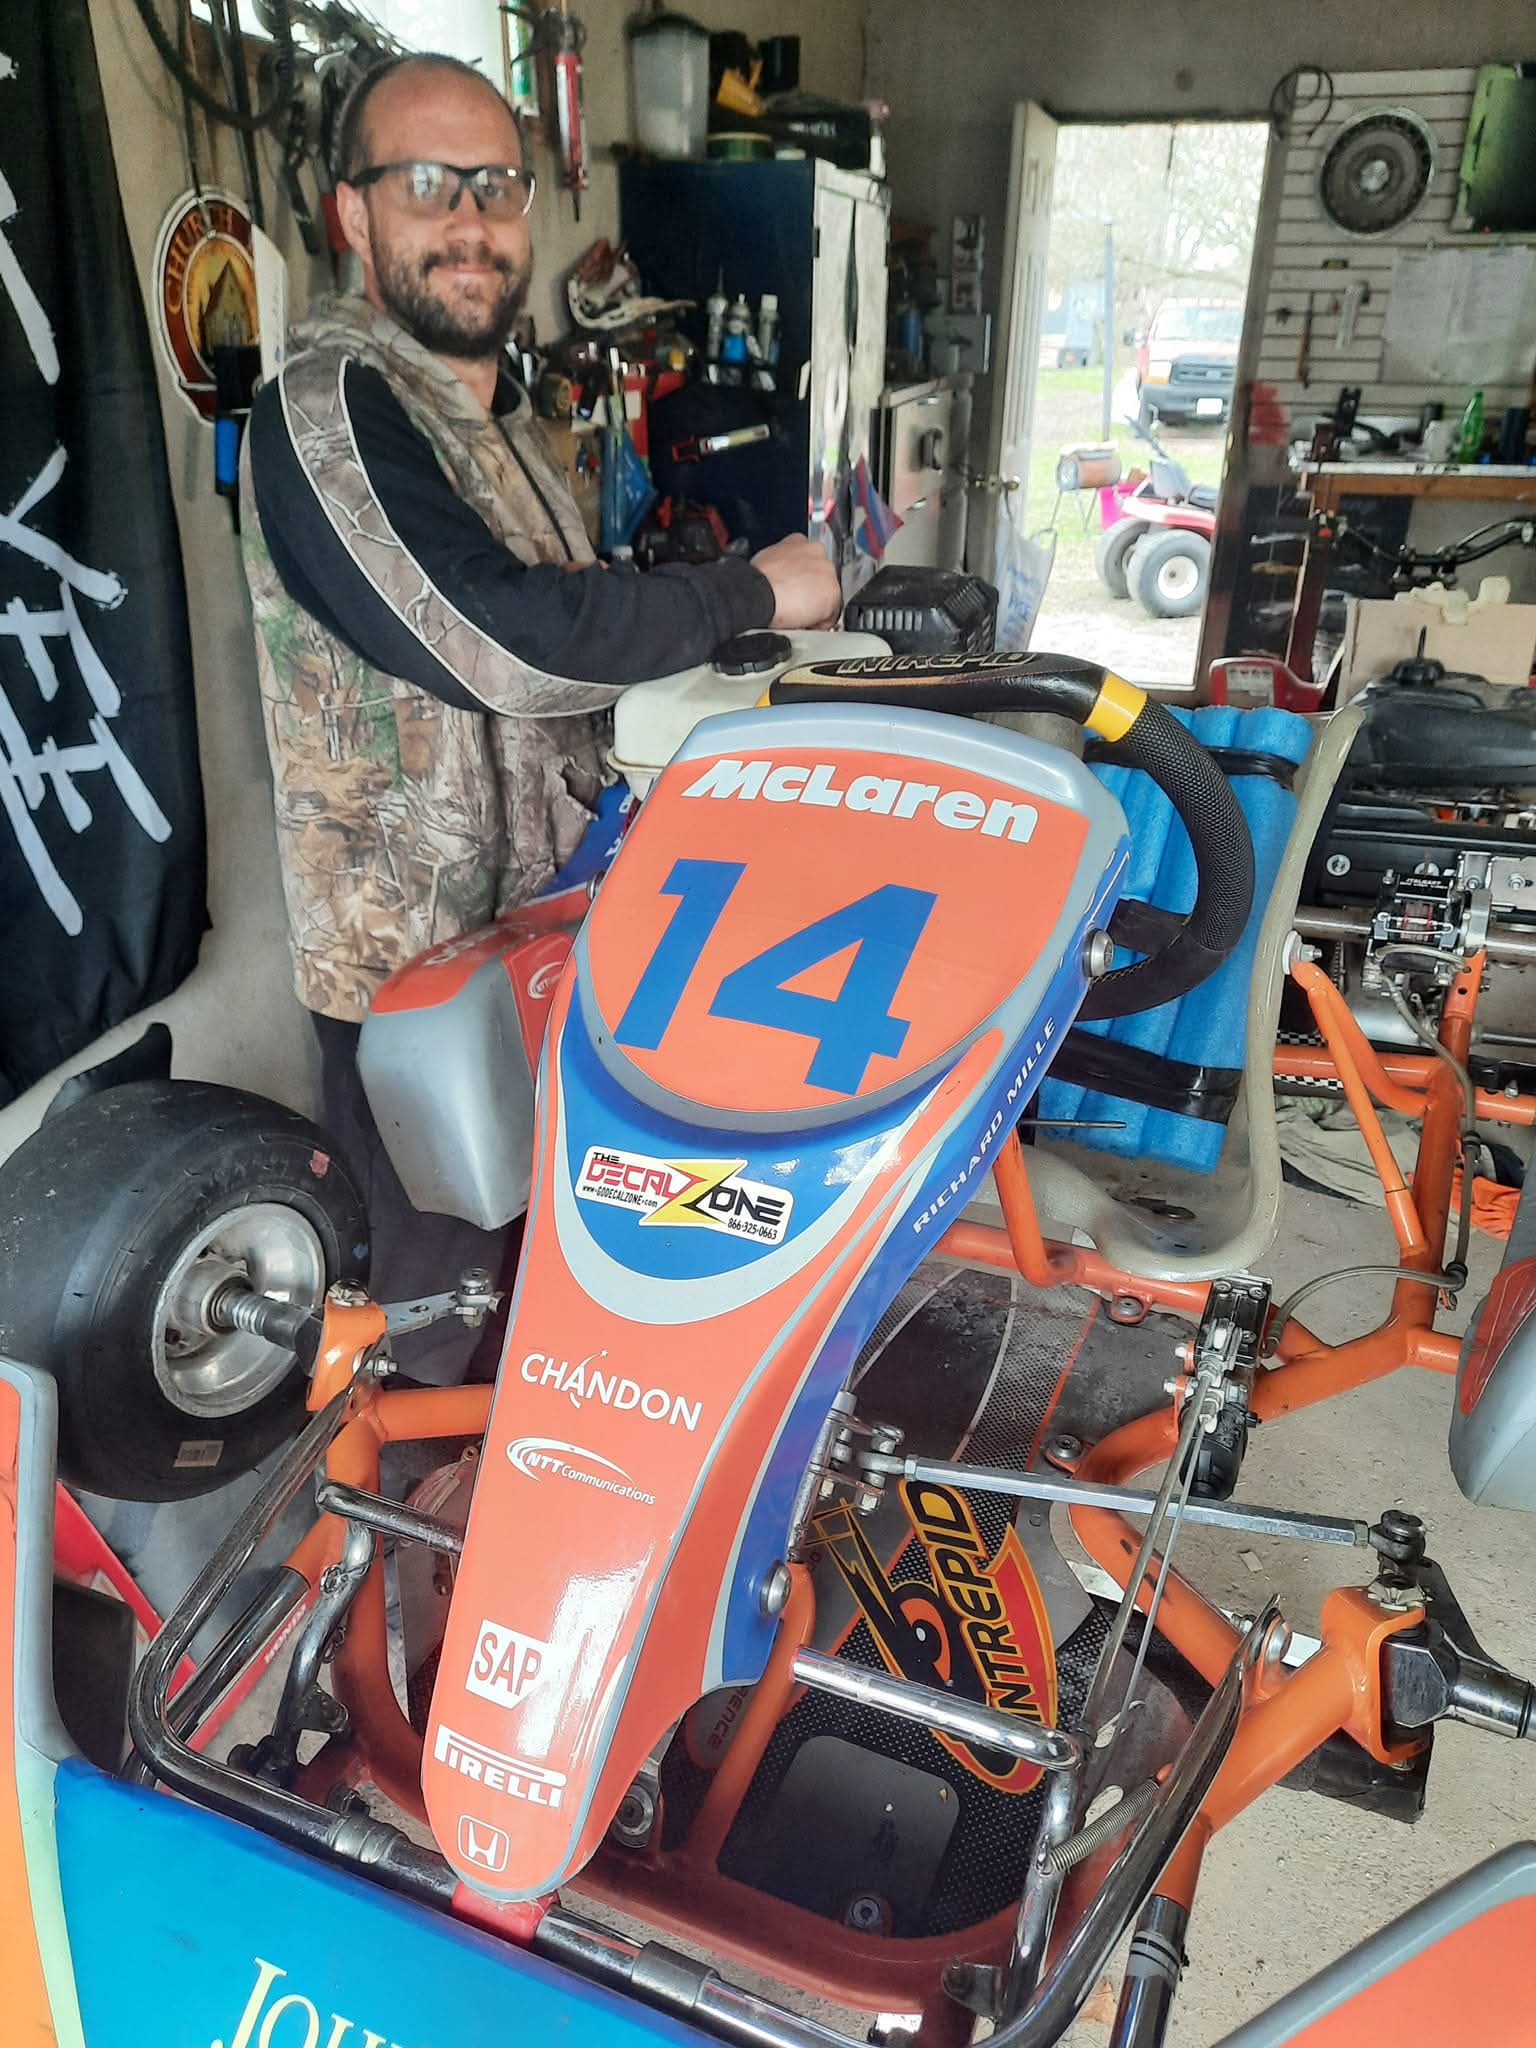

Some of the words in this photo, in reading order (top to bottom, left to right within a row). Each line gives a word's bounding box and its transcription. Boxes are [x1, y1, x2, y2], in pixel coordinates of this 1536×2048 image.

[681, 759, 1039, 844] McLaren
[615, 858, 938, 1096] 14
[593, 1151, 621, 1165] THE
[911, 1110, 1003, 1234] RICHARD
[1006, 1016, 1056, 1105] MILLE
[520, 1352, 704, 1432] CHANDON
[525, 1451, 563, 1474] NTT
[561, 1465, 657, 1506] Communications
[474, 1631, 542, 1697] SAP
[433, 1723, 567, 1808] PIRELLI
